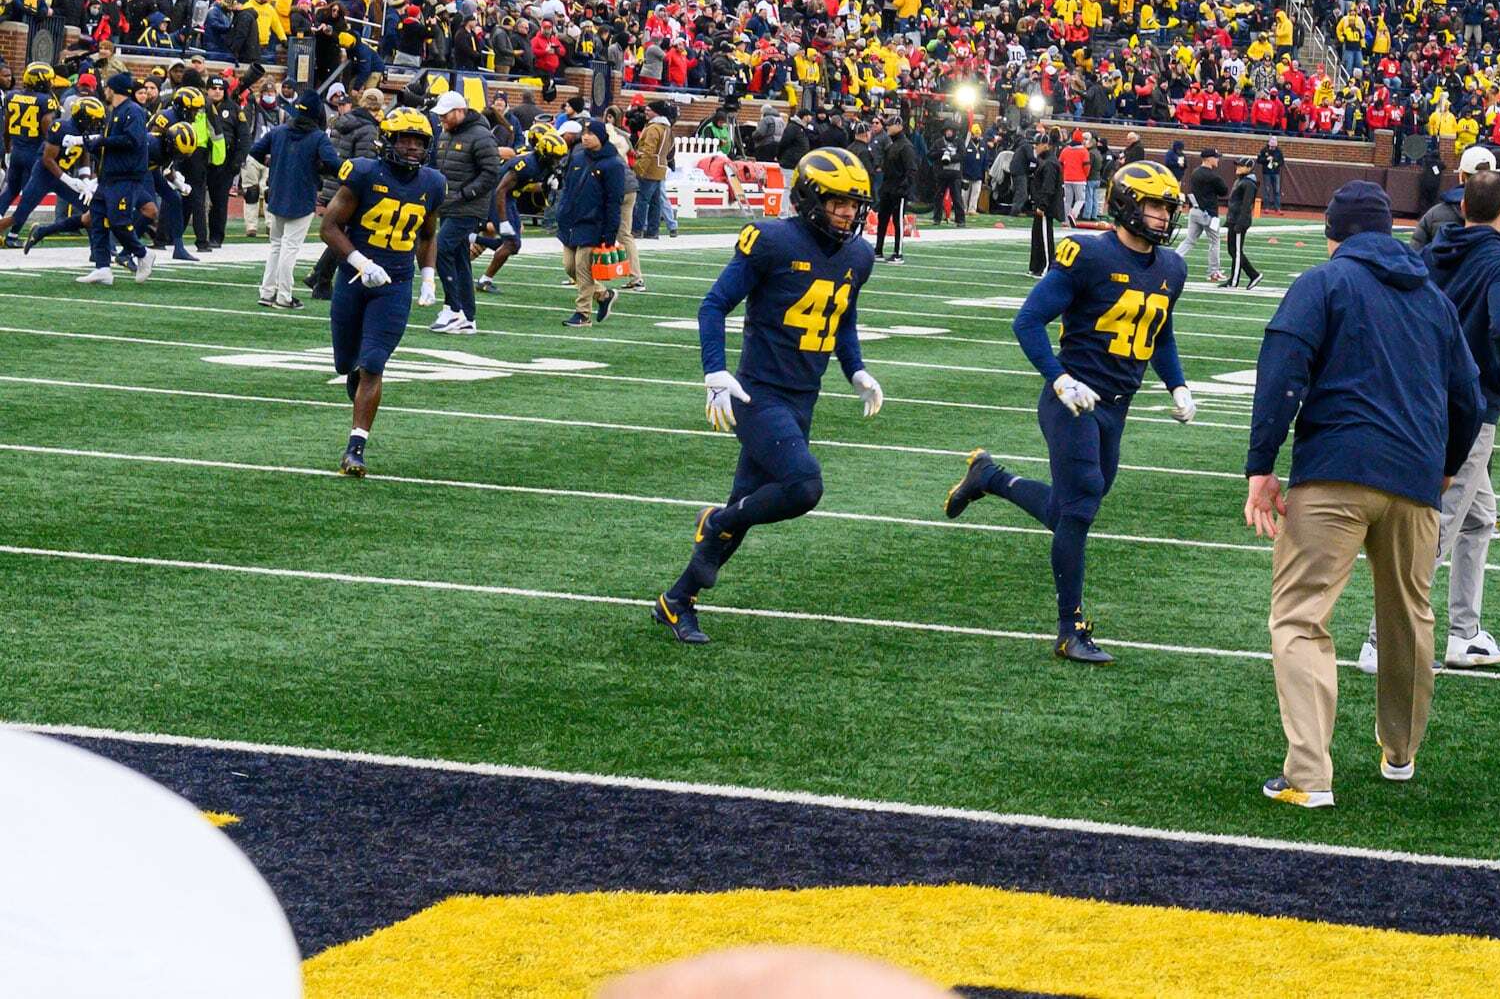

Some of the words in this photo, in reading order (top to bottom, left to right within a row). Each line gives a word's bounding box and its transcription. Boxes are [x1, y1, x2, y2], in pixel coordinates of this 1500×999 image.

[8, 102, 39, 137] 24
[361, 197, 426, 252] 40
[767, 196, 777, 206] G
[783, 278, 852, 352] 41
[1094, 289, 1170, 361] 40
